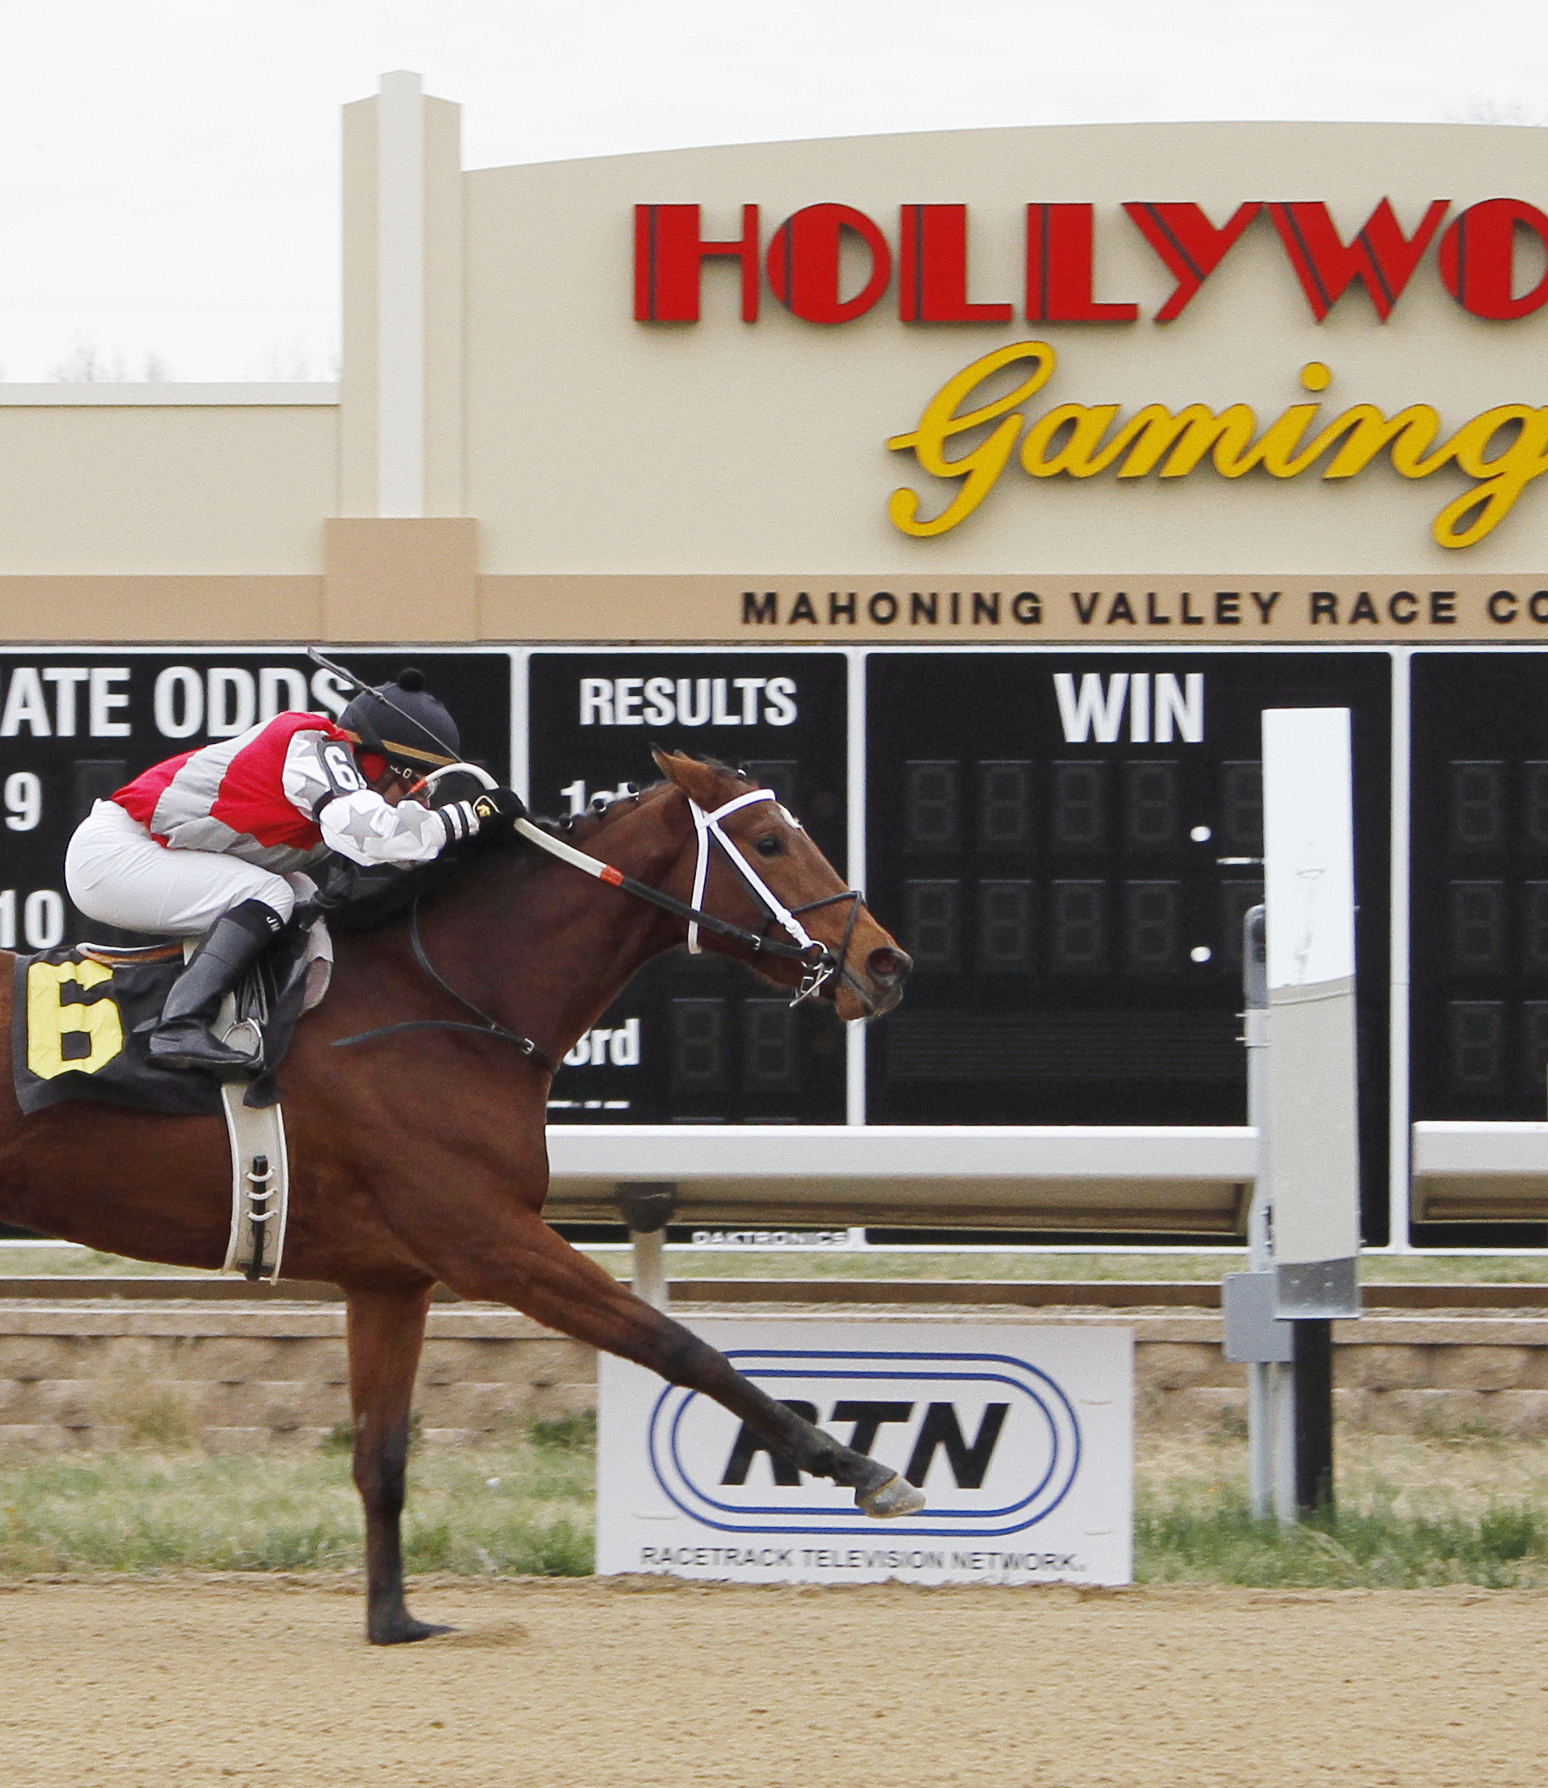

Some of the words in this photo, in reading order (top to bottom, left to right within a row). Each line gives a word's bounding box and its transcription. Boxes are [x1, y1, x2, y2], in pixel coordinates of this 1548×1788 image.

[634, 197, 1548, 324] HOLLYWO
[886, 340, 1548, 549] Gaming
[741, 591, 1043, 626] MAHONING
[1070, 591, 1282, 626] VALLEY
[1309, 591, 1457, 625] RACE
[154, 666, 355, 738] ODDS
[579, 676, 798, 726] RESULTS
[1053, 672, 1204, 743] WIN
[4, 771, 43, 832] 9
[324, 745, 360, 792] 6
[26, 958, 124, 1080] 6
[642, 1546, 793, 1569] RACETRACK
[803, 1549, 943, 1570] TELEVISION
